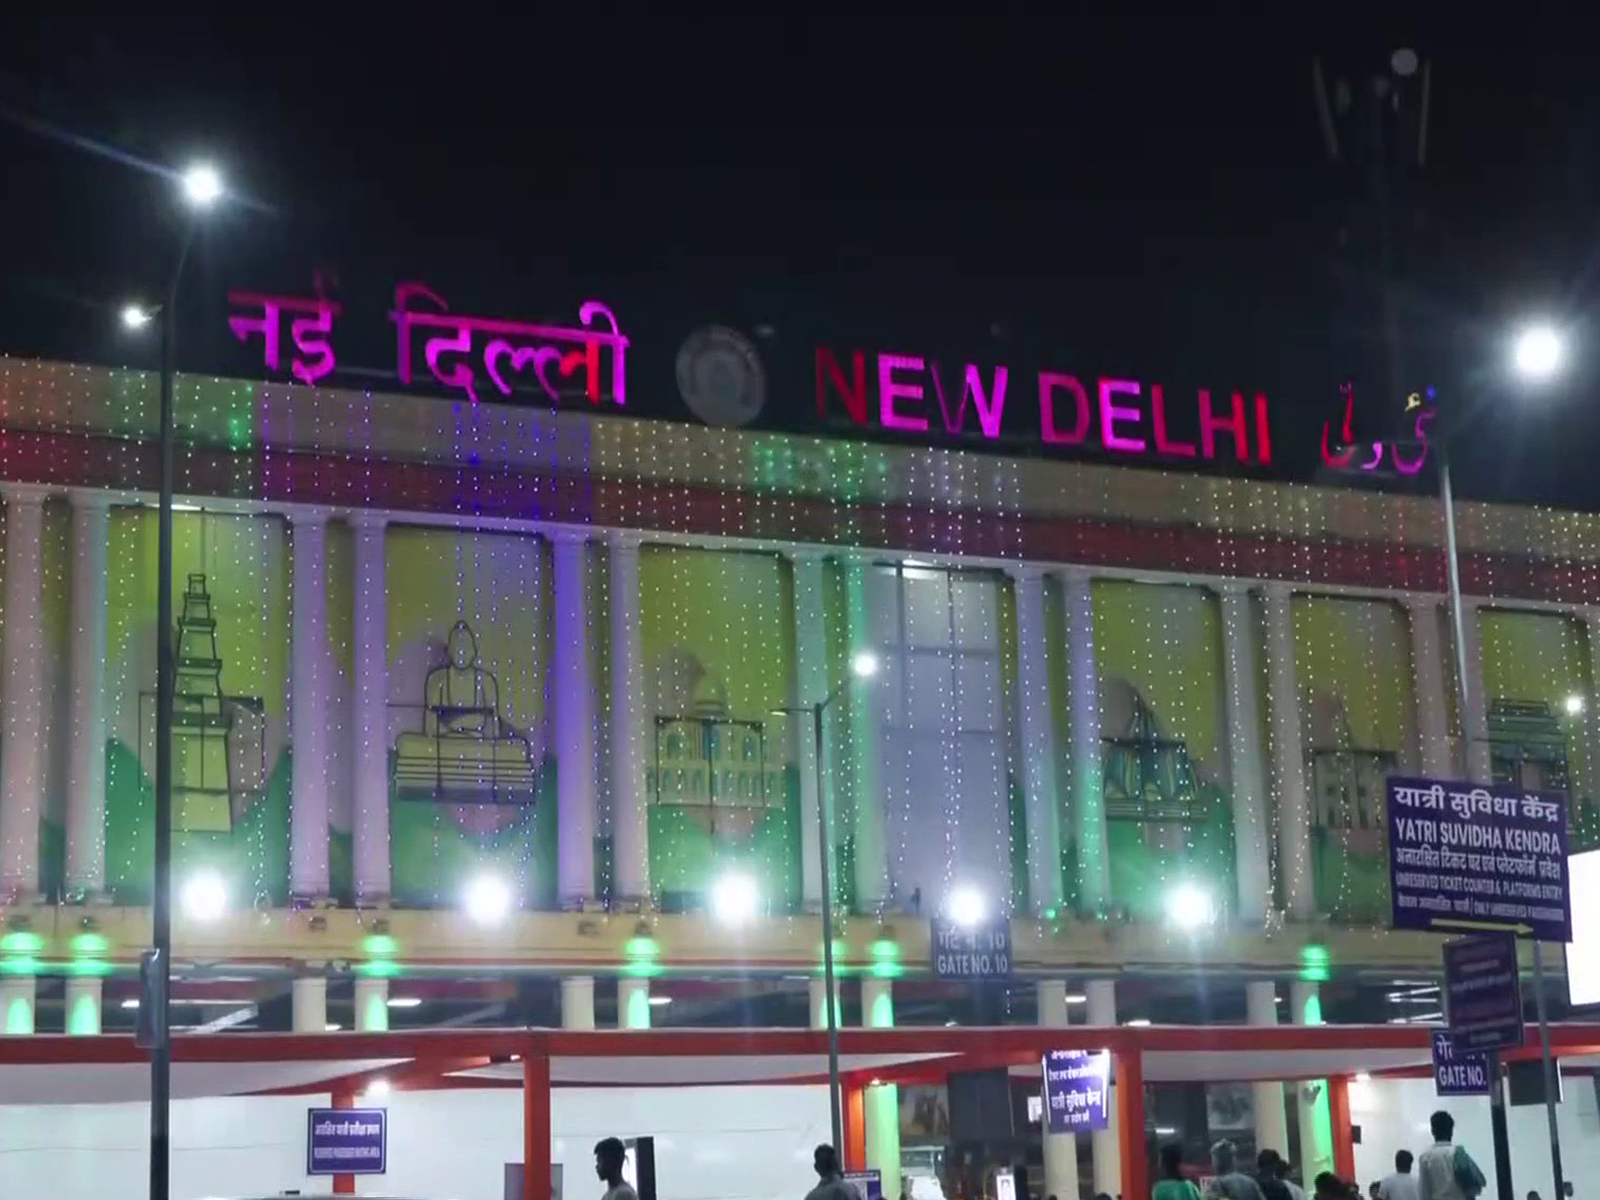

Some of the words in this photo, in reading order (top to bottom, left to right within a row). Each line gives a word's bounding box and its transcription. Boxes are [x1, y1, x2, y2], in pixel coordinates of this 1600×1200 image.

[228, 268, 340, 386] नई
[389, 283, 629, 404] दिल्ली
[815, 346, 1008, 439] NEW
[1038, 371, 1271, 466] DELHI
[1394, 785, 1444, 810] यात्री
[1449, 789, 1517, 819] सुविधा
[1521, 795, 1559, 822] केंद्र
[1396, 817, 1437, 843] YATRI
[1440, 822, 1502, 850] SUVIDHA
[1505, 828, 1562, 855] KENDRA
[1440, 875, 1462, 891] TICKET
[938, 954, 969, 975] GATE
[971, 953, 993, 975] NO.
[995, 953, 1008, 974] 10
[1438, 1064, 1465, 1087] GATE
[1467, 1067, 1487, 1087] NO.
